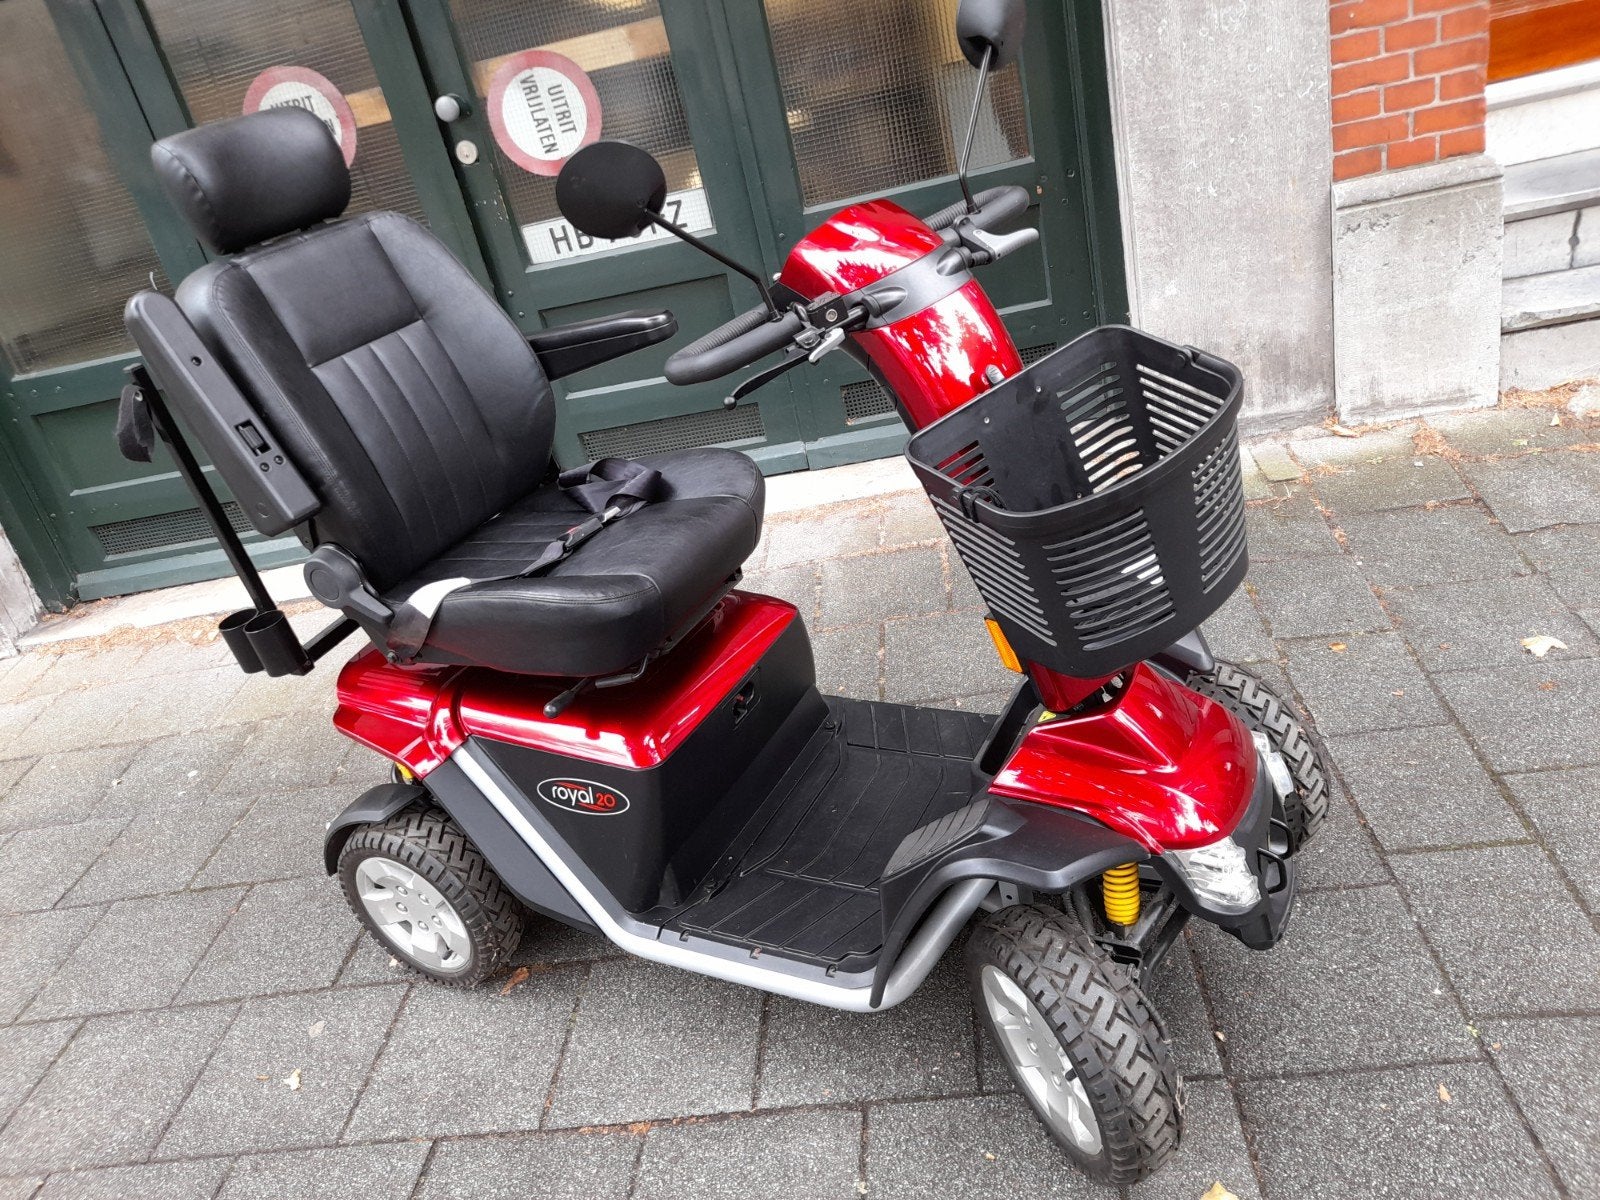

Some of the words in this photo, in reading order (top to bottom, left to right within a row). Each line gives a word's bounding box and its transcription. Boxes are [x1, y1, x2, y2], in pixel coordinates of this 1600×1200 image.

[520, 75, 559, 154] VRIJLATEN
[547, 84, 577, 133] UITRIT
[552, 786, 594, 806] royal
[596, 792, 616, 808] 20
